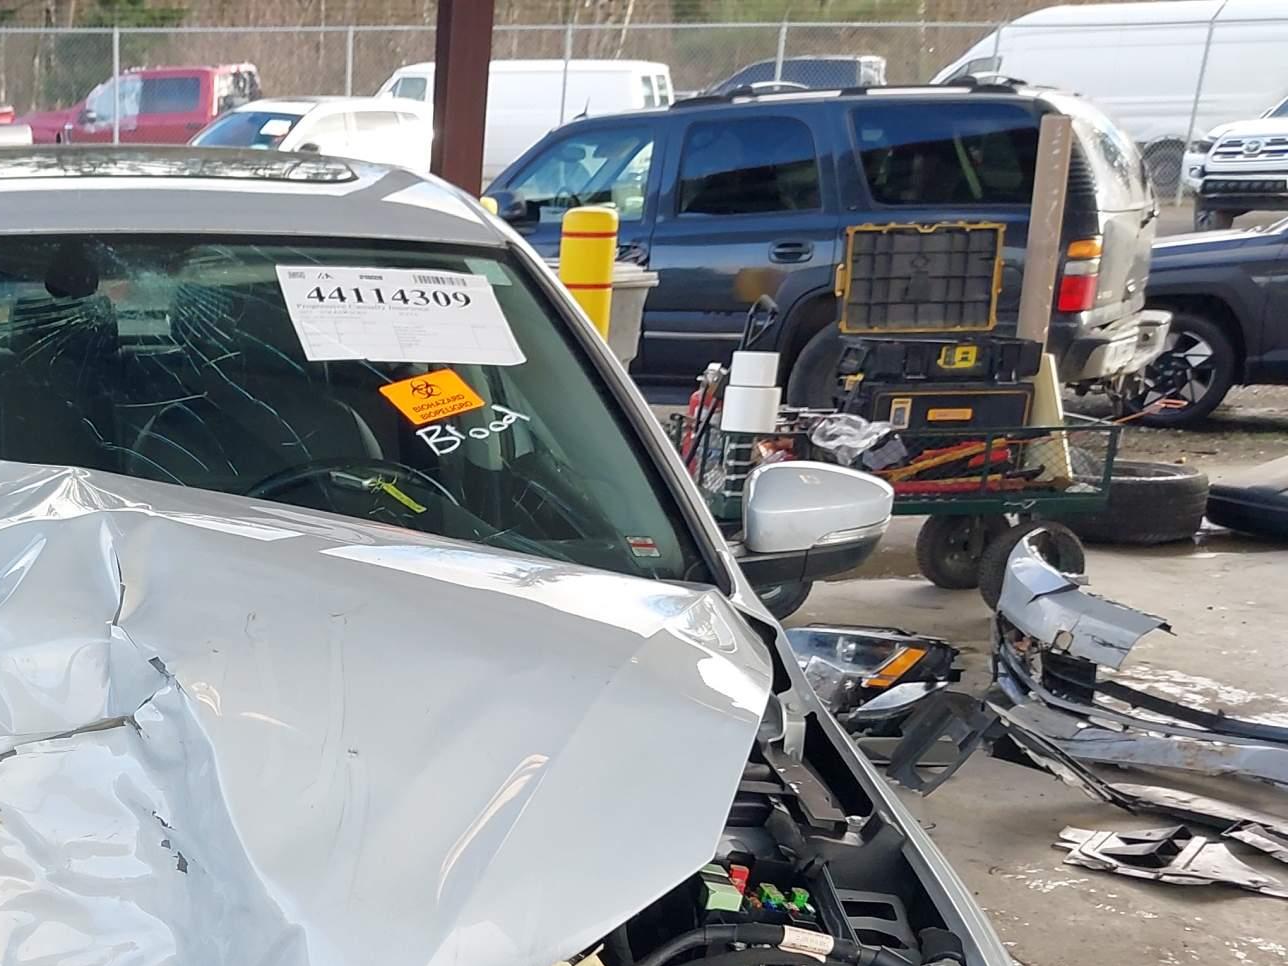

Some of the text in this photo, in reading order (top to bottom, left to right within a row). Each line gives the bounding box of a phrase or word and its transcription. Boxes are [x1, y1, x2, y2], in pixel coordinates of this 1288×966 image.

[307, 286, 471, 308] 44114309
[412, 393, 465, 413] BIOHAZARD
[420, 401, 473, 420] BIOPELIGRO
[415, 404, 531, 456] Blood
